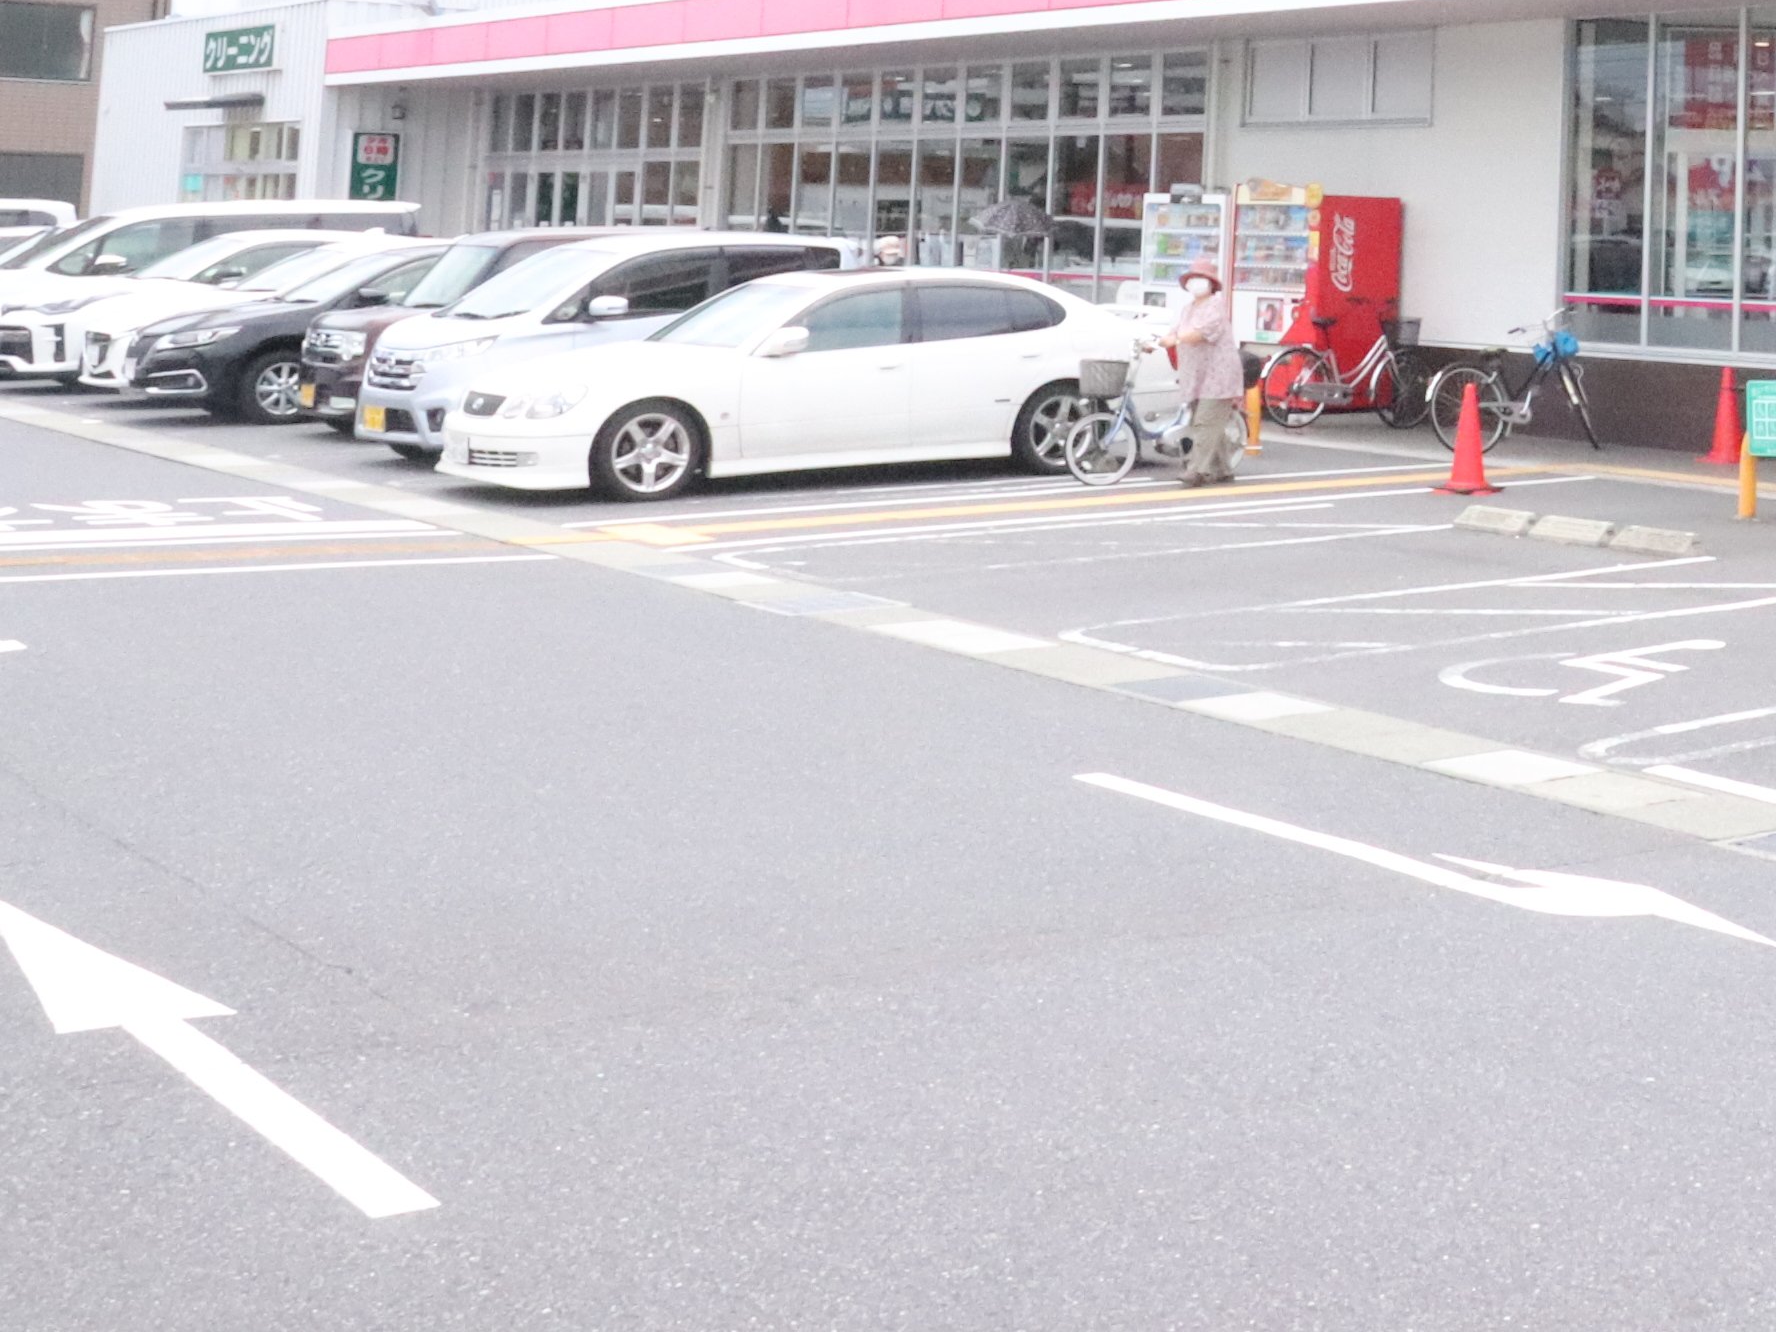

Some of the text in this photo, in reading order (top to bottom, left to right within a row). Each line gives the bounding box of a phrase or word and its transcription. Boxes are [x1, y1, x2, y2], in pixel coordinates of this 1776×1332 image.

[205, 29, 273, 69] クリーニング
